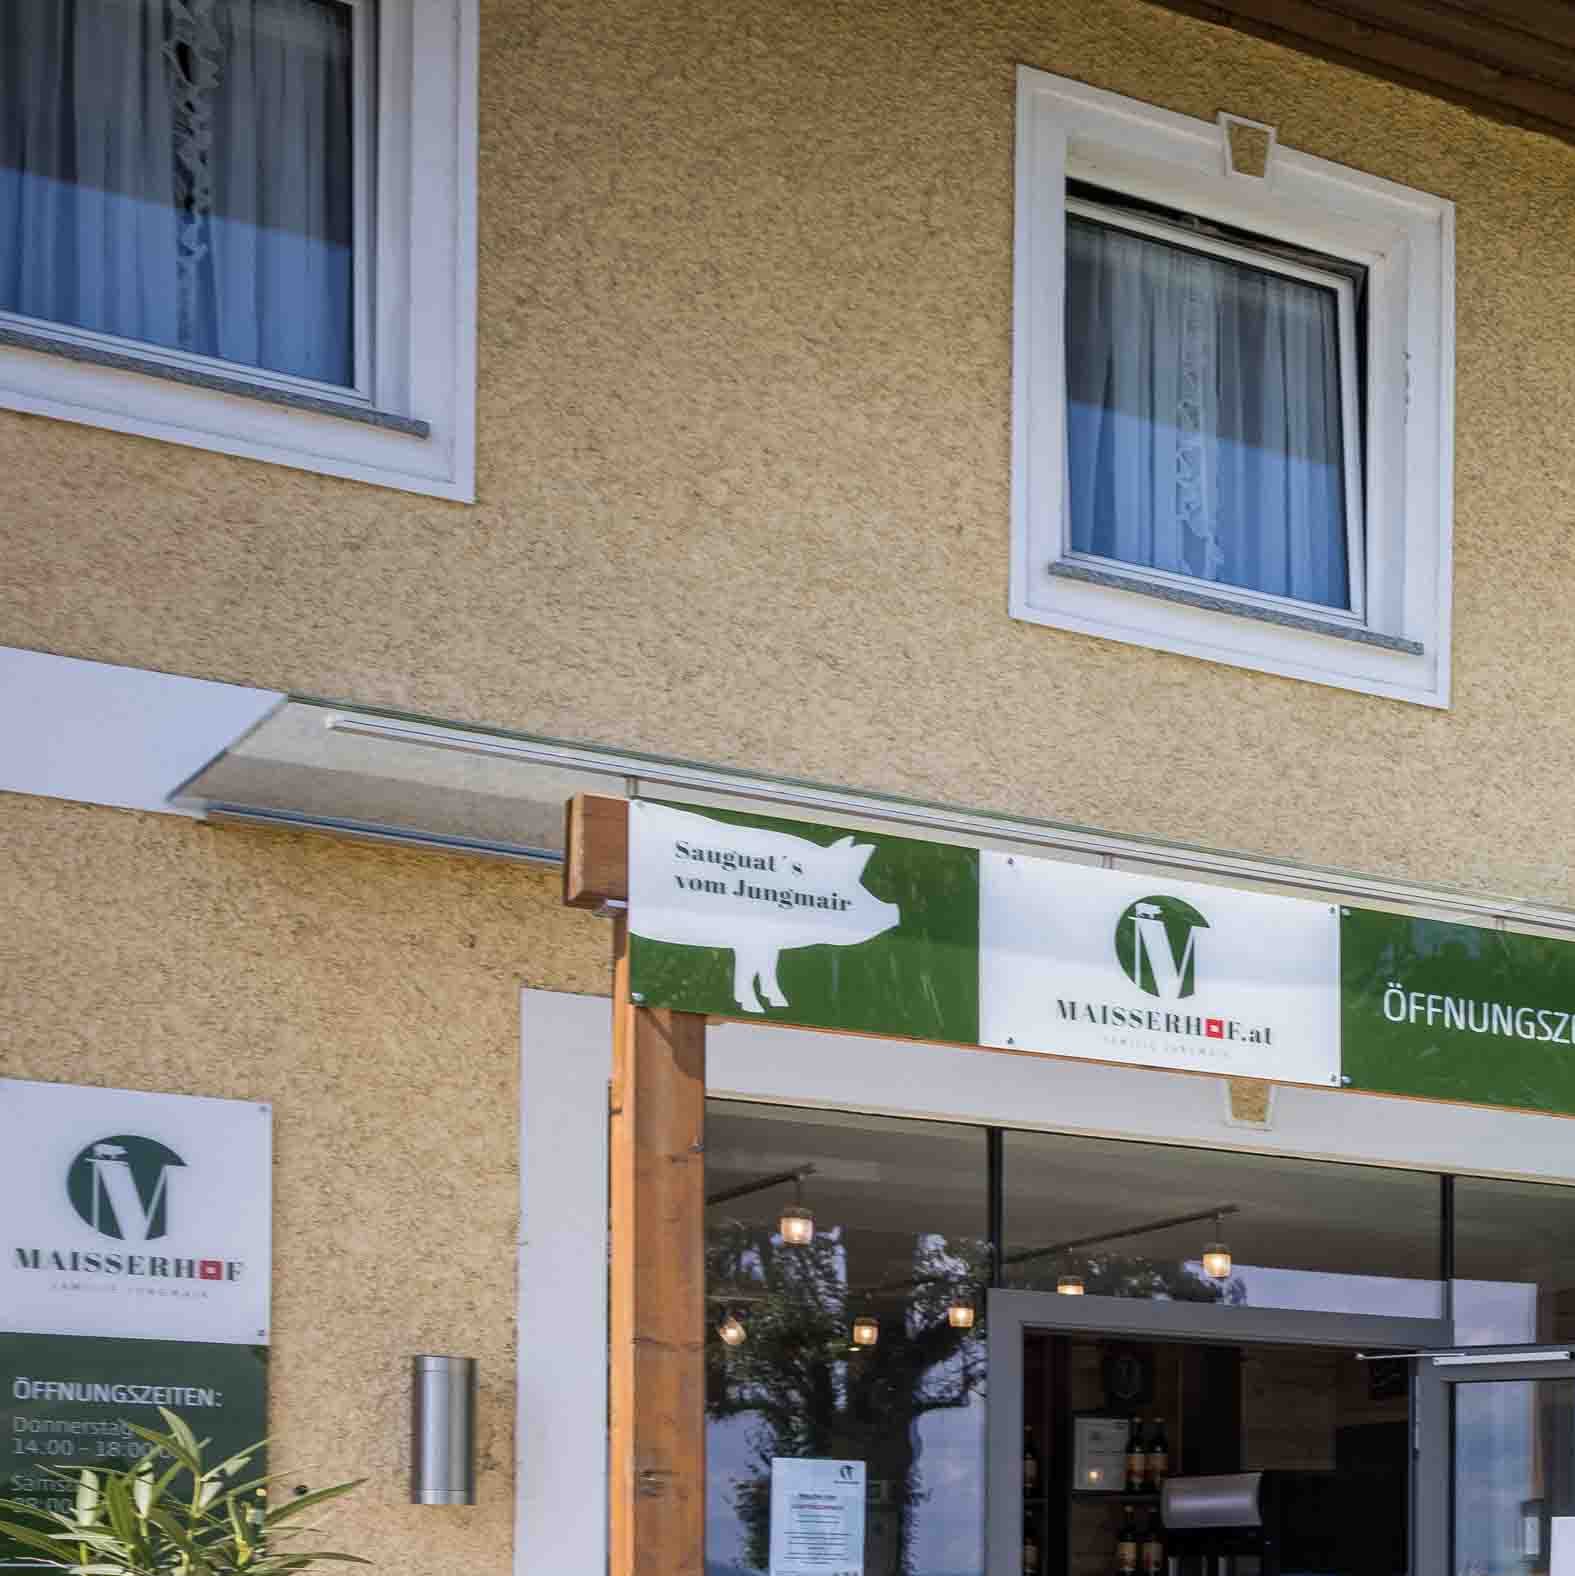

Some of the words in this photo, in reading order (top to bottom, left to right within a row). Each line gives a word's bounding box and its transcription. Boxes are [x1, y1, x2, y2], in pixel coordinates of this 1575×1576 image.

[674, 875, 727, 895] vom
[733, 879, 852, 912] Jungmair
[13, 1376, 224, 1407] ÖFFNUNGSZEITEN:
